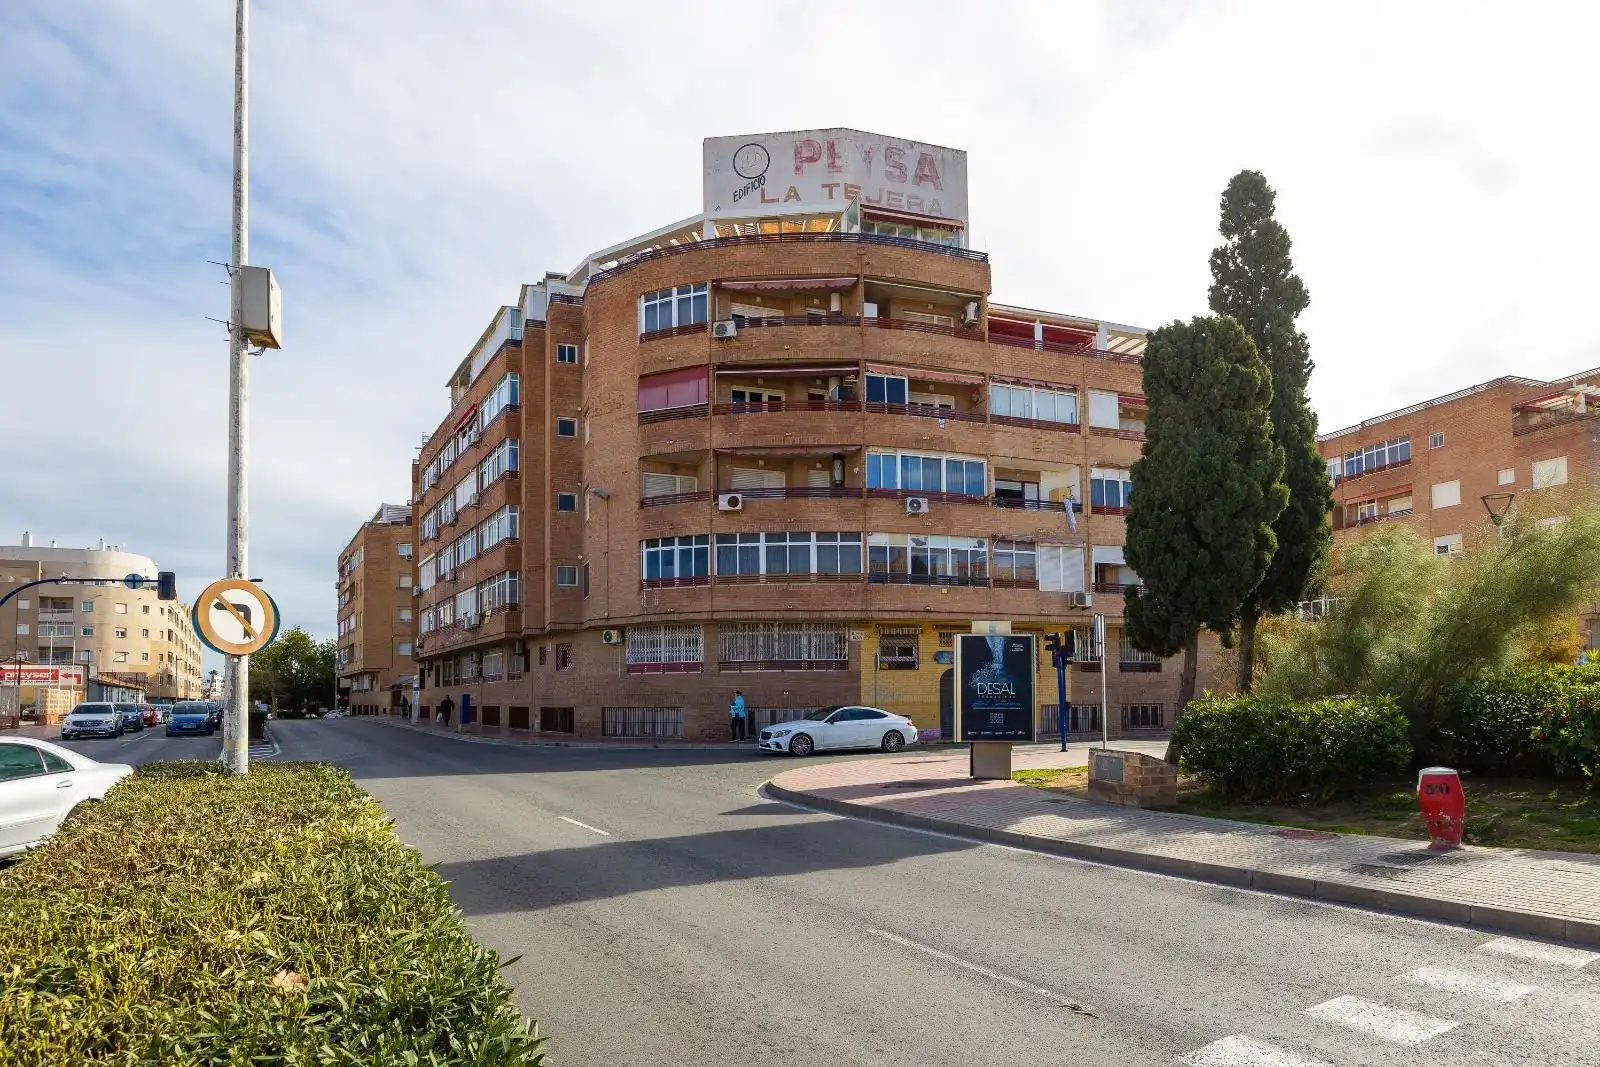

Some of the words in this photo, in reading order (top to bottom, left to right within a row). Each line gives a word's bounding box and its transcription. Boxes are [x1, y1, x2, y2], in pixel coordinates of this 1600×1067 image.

[733, 175, 766, 202] EDIFICIO
[761, 185, 801, 204] LA
[821, 183, 943, 215] TEJERA
[977, 682, 1016, 695] DESAL
